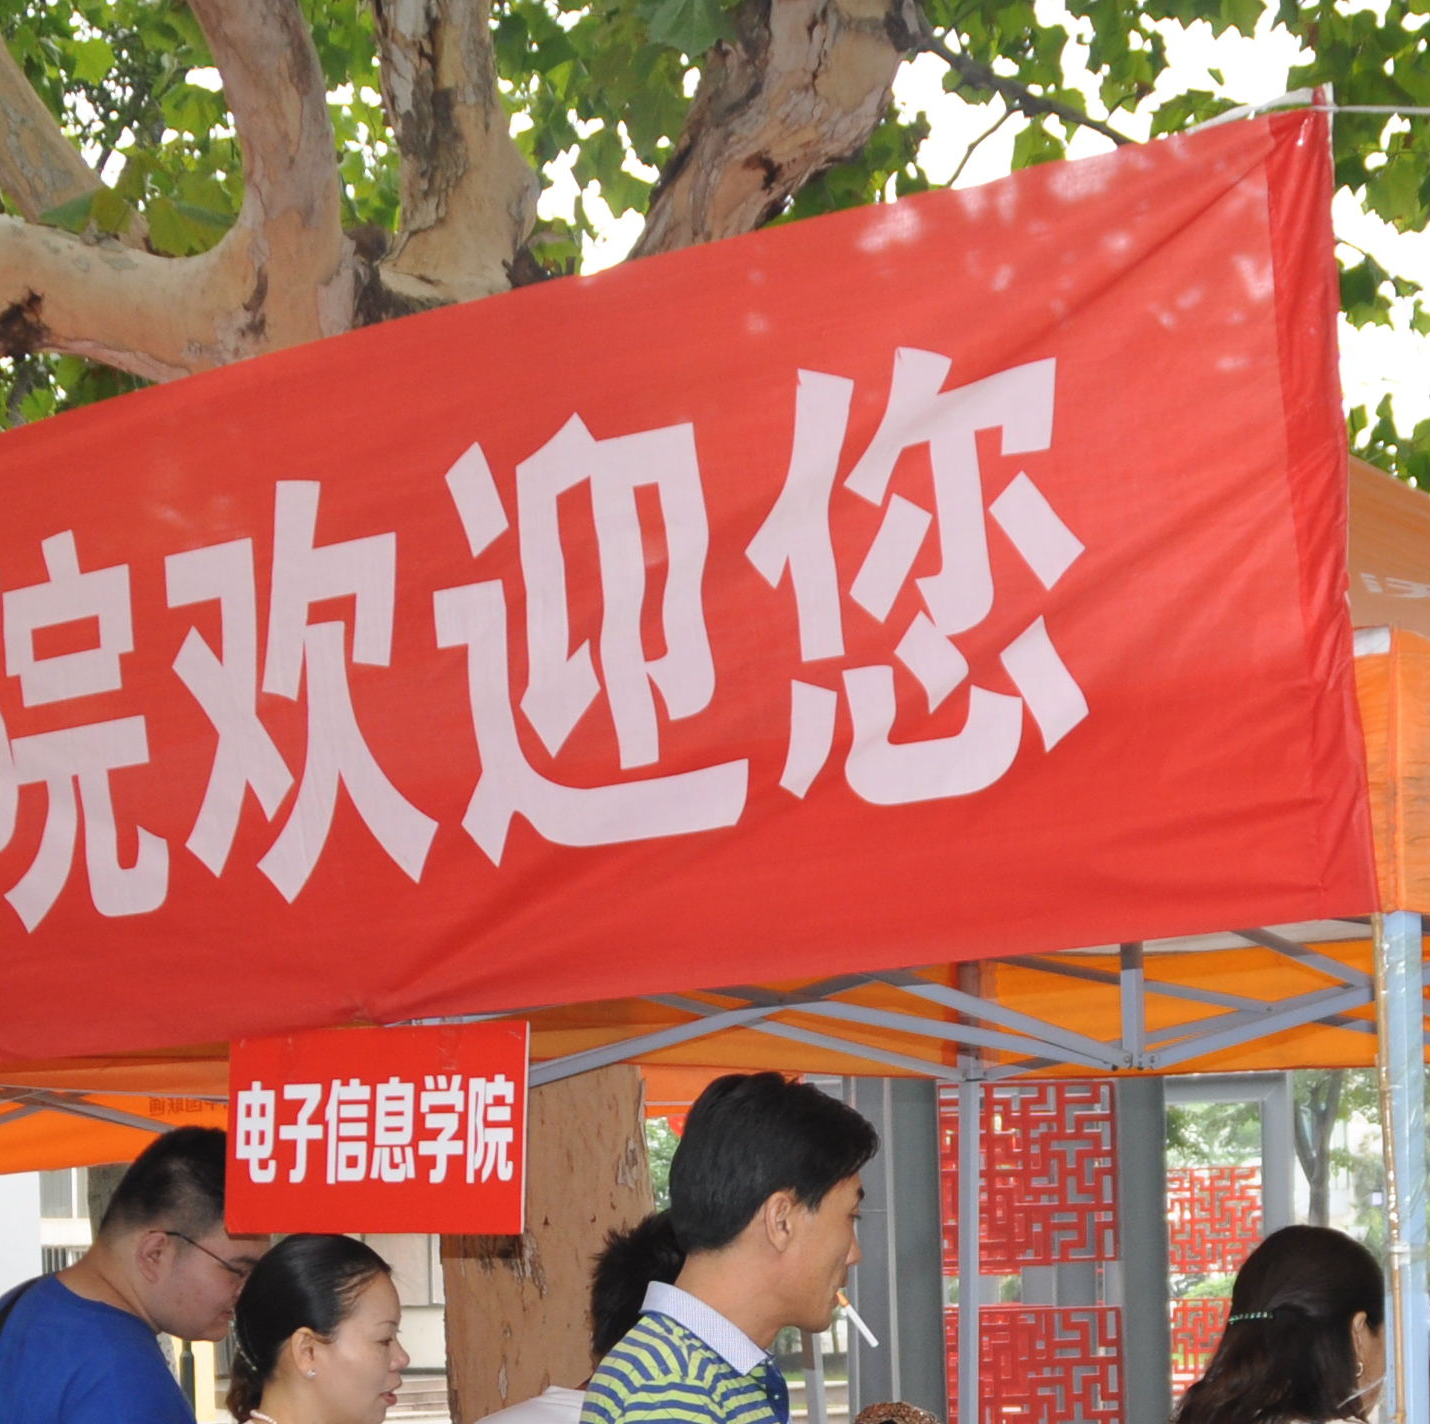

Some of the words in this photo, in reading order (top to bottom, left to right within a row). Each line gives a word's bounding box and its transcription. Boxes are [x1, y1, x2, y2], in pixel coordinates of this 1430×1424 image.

[235, 1073, 515, 1184] 电子信息学院
